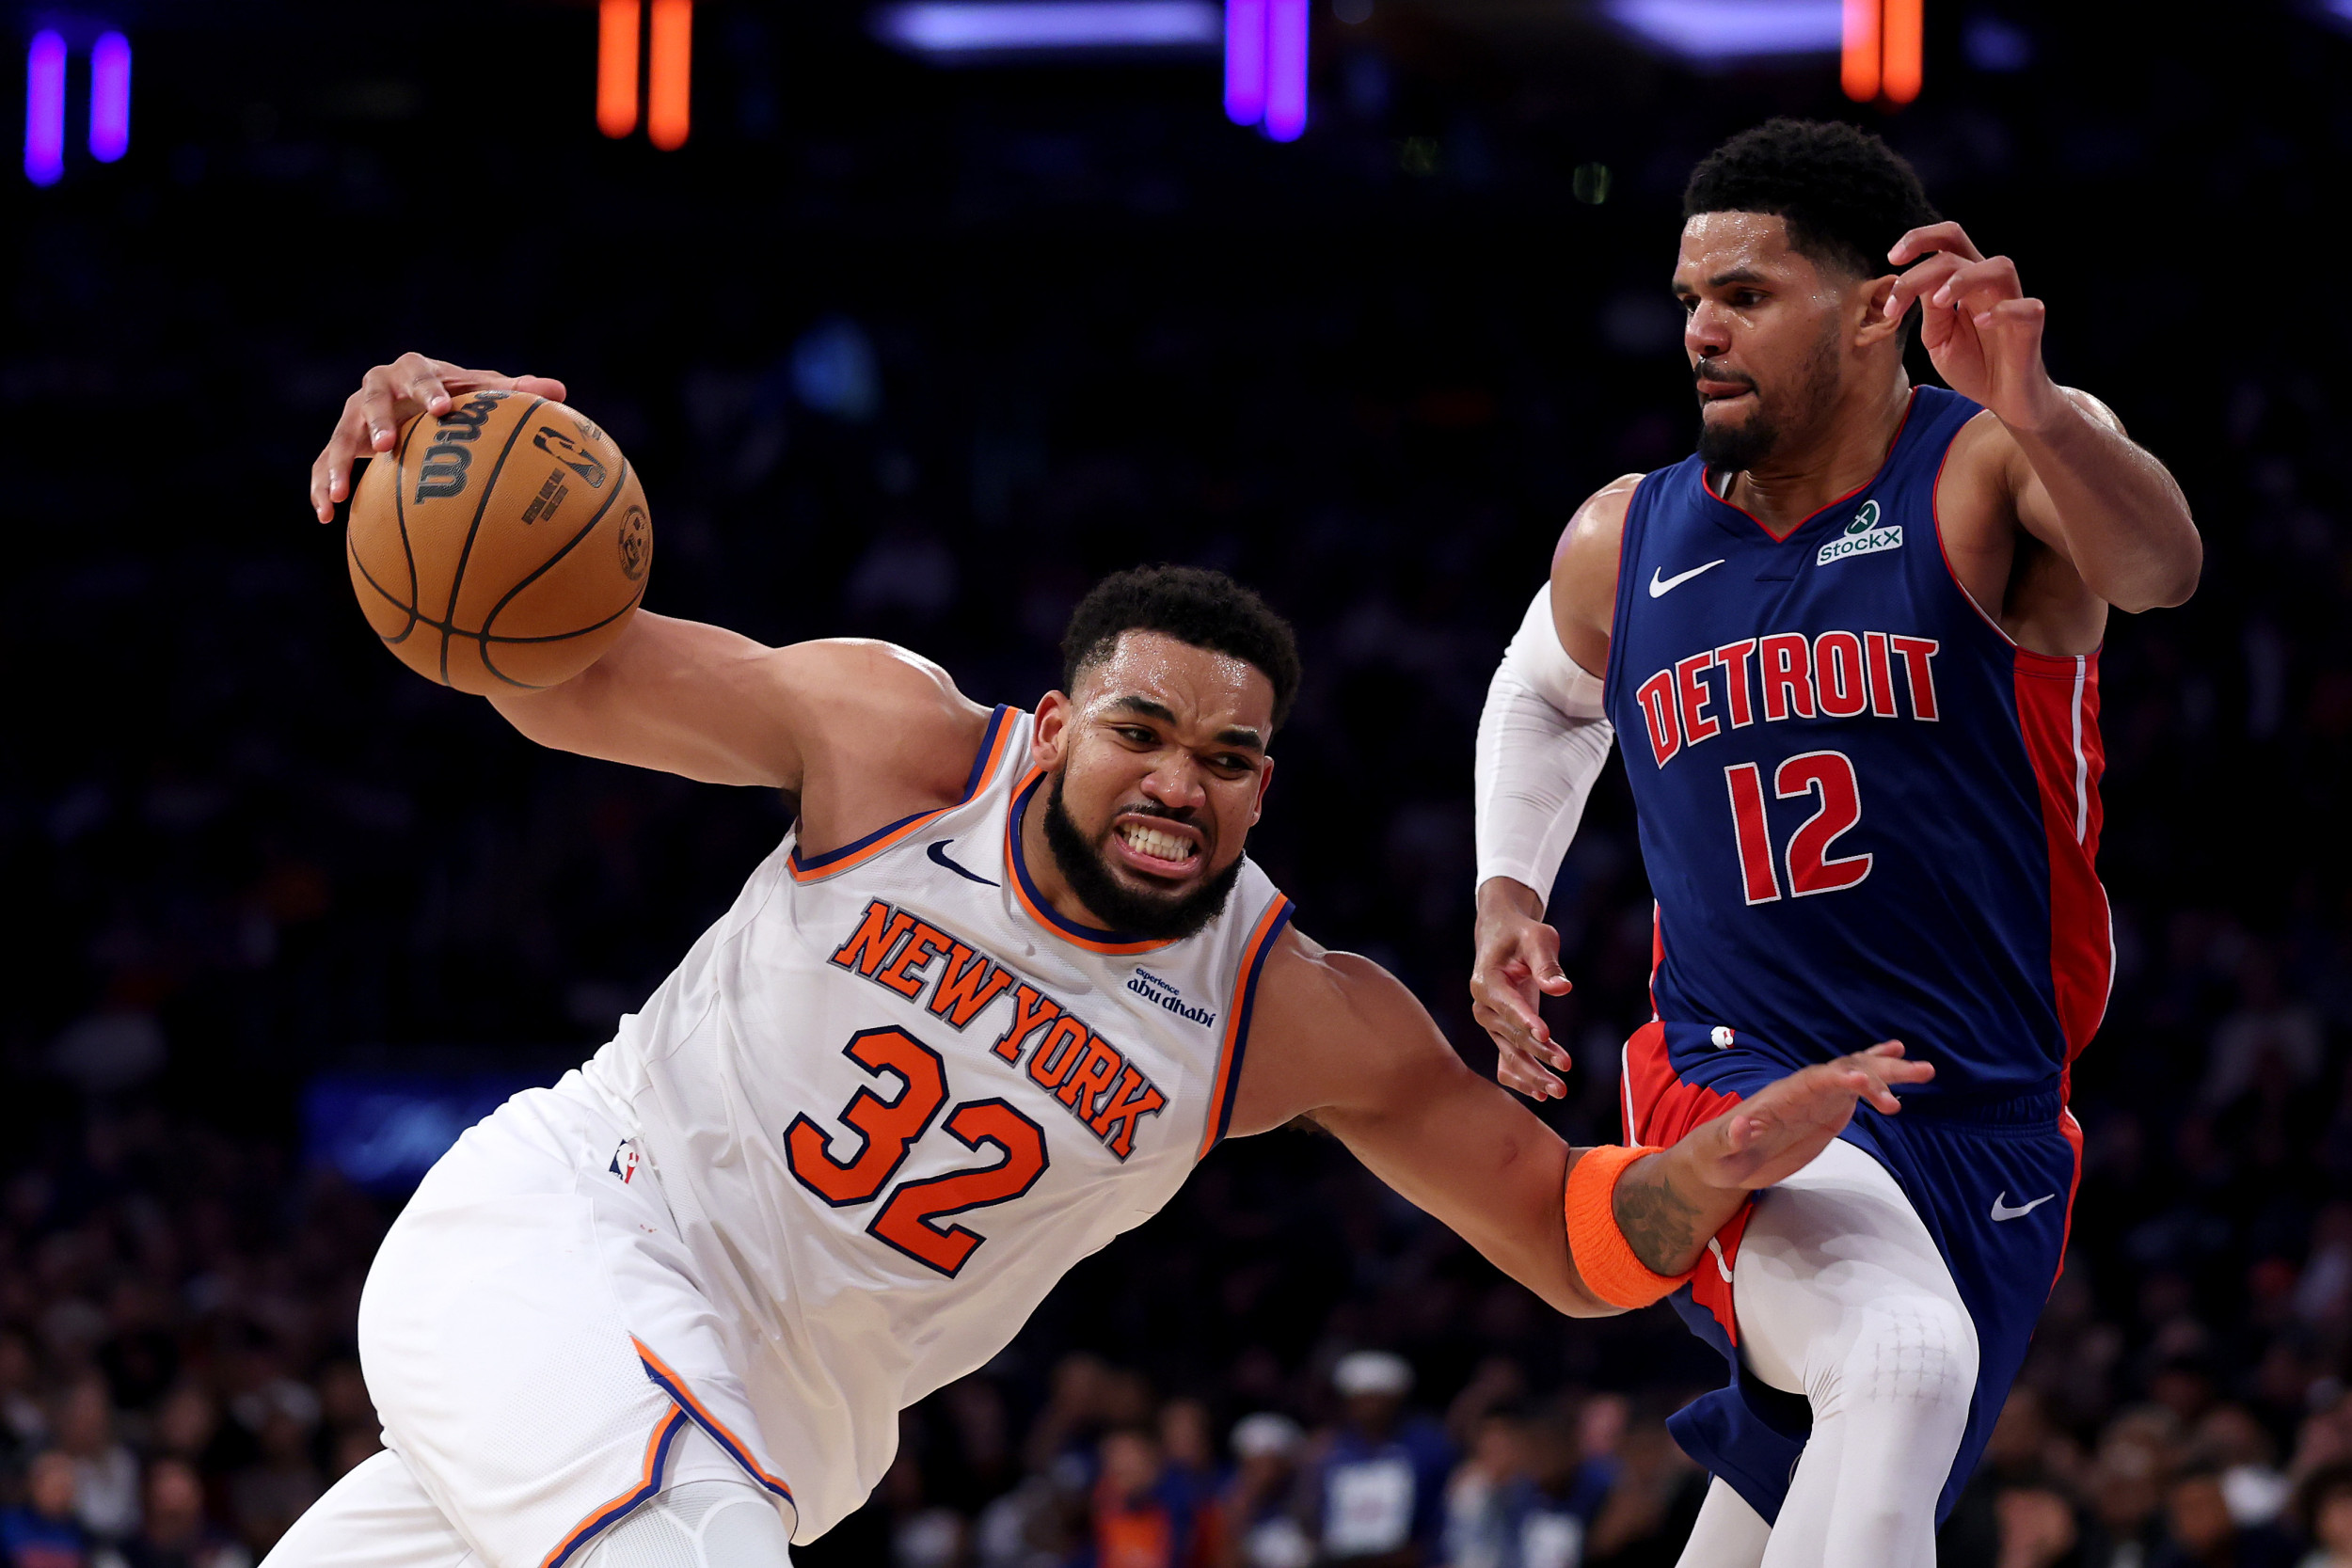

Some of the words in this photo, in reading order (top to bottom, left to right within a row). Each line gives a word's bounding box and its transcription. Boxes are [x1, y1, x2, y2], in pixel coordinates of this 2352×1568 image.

[414, 389, 514, 505] Wilso
[1820, 528, 1900, 562] StockX
[1636, 630, 1939, 769] DETROIT
[1724, 750, 1873, 906] 12
[827, 896, 1019, 1033] NEW
[990, 981, 1169, 1164] YORK
[1127, 978, 1161, 1004] abu
[1136, 967, 1180, 996] experience
[783, 1024, 1049, 1278] 32
